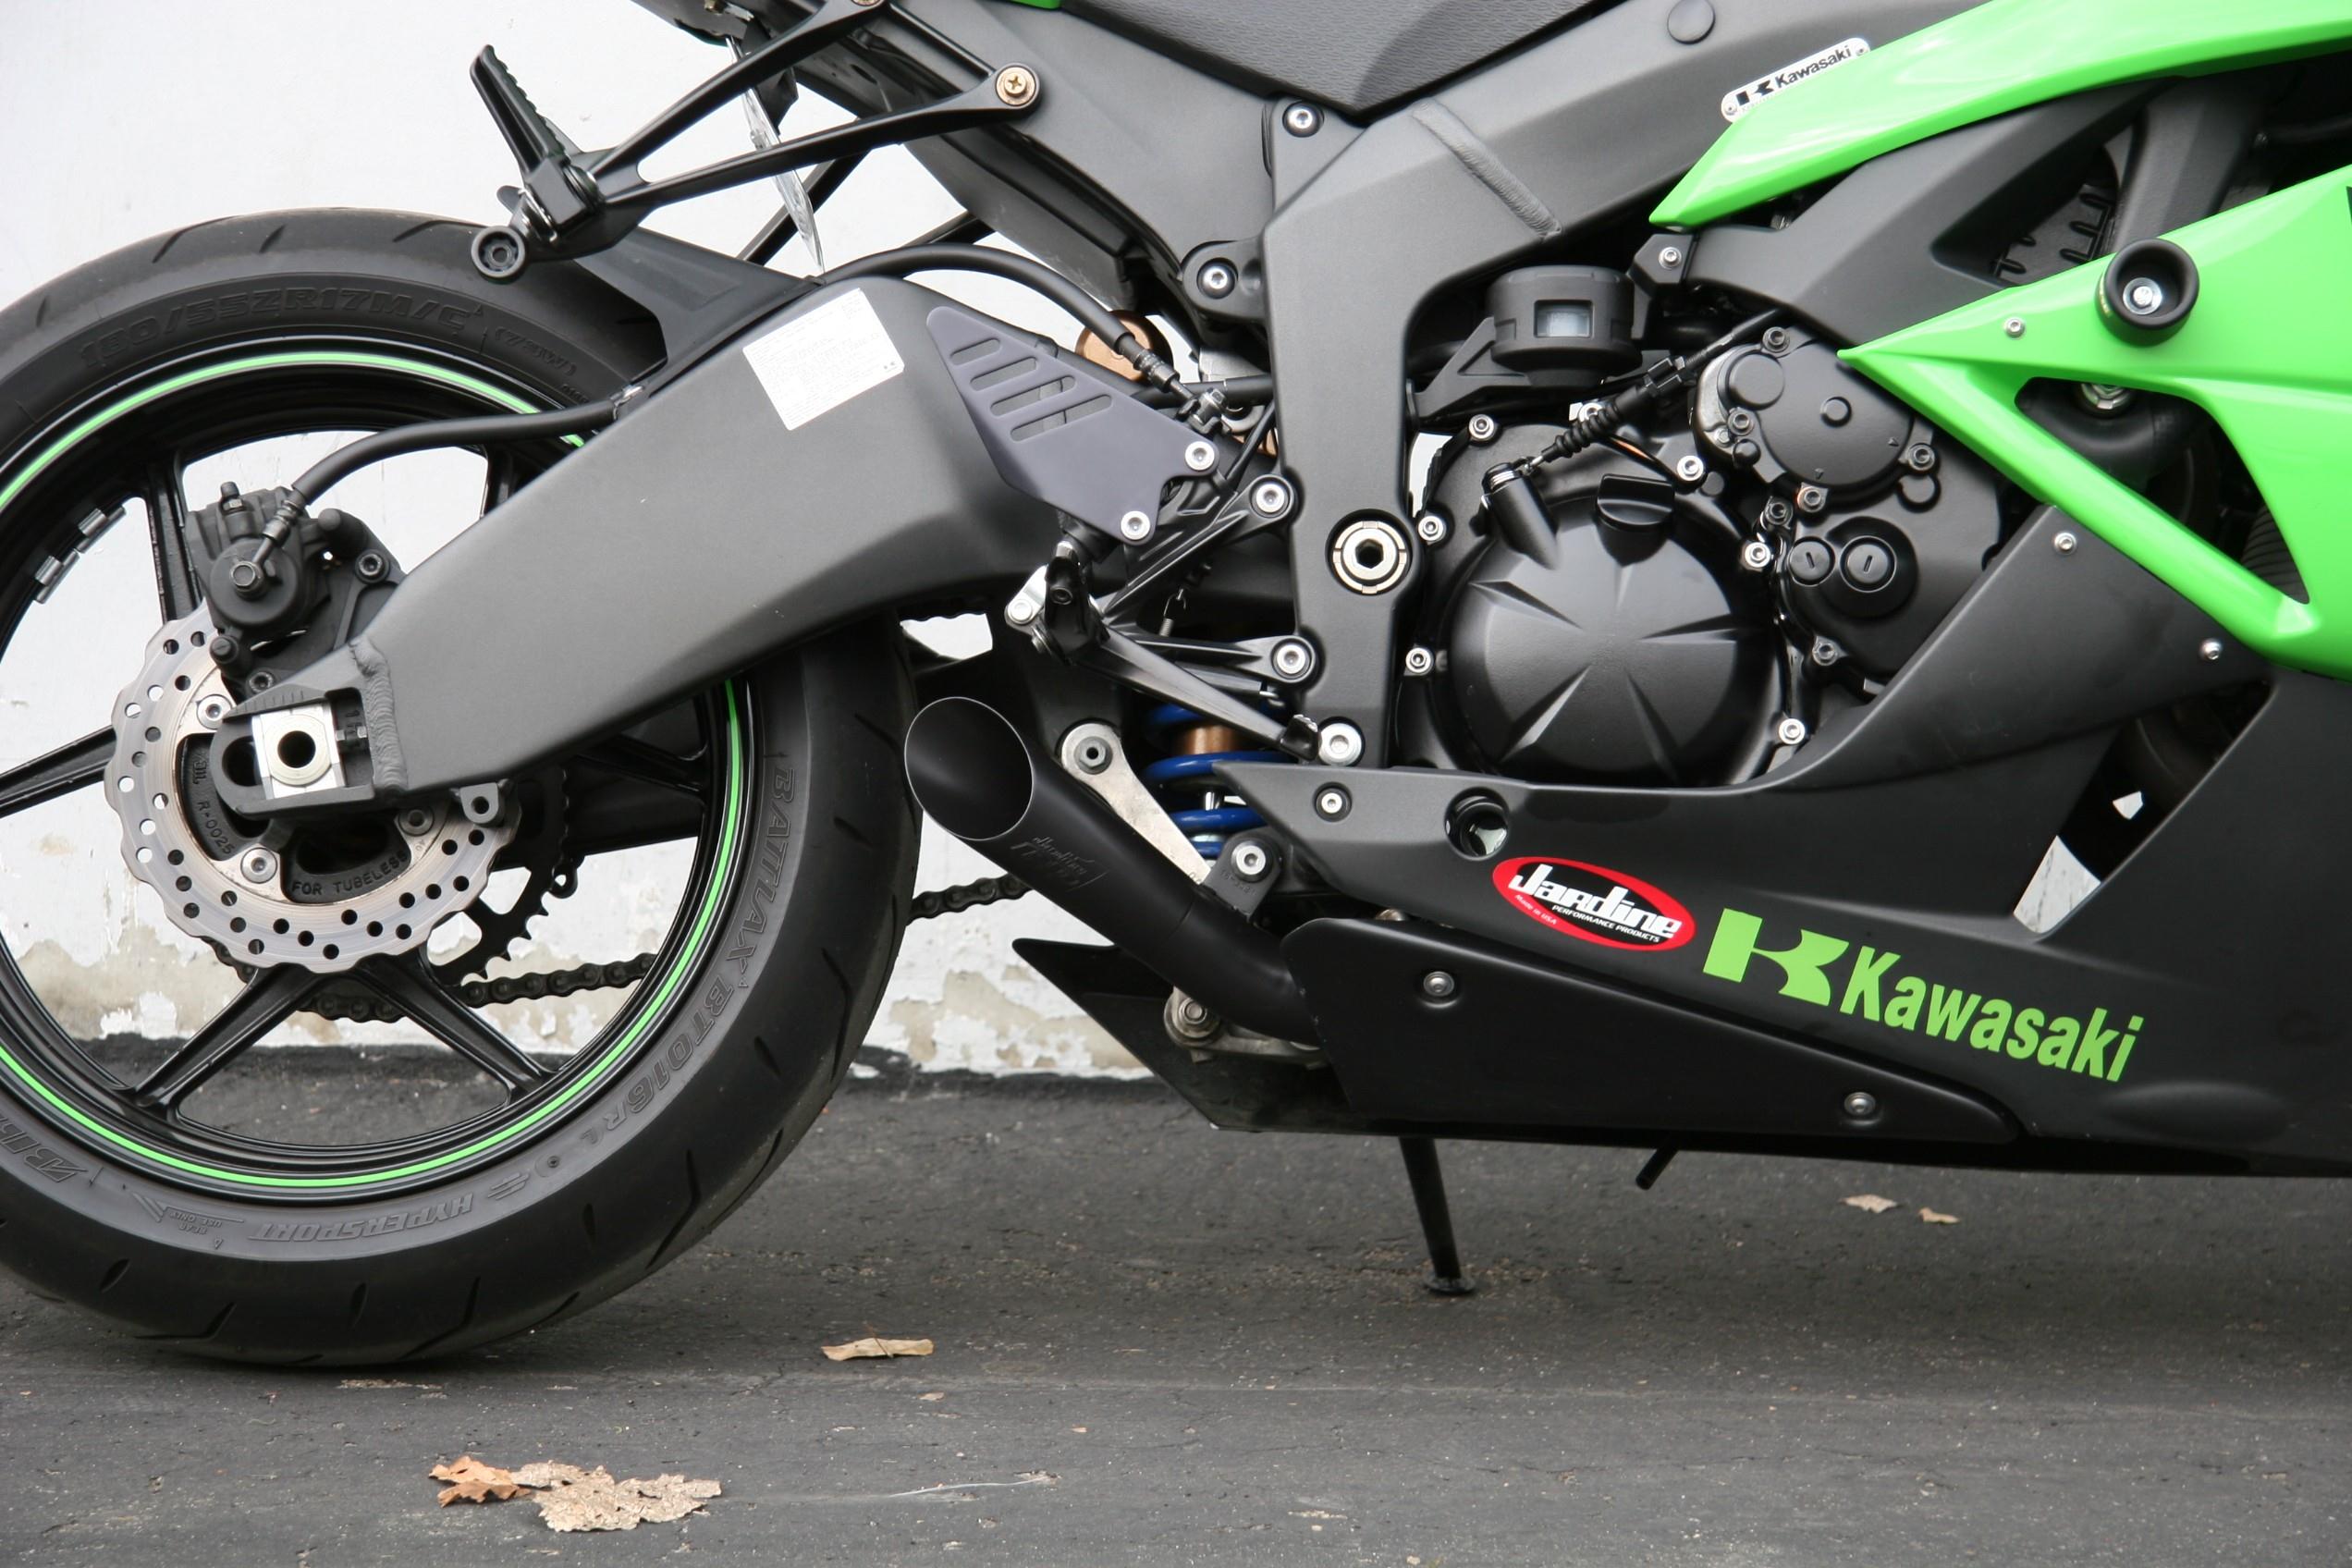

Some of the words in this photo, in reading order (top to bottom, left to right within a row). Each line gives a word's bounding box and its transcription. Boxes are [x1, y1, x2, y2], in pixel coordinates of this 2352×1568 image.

[1775, 46, 1851, 89] Kawasaki
[197, 801, 235, 854] R-0025
[291, 880, 323, 896] FOR
[333, 849, 408, 893] TUBELESS
[727, 768, 795, 975] BATTLAX
[1508, 864, 1683, 938] Jardine
[1513, 894, 1534, 912] Made
[1540, 912, 1558, 925] USA
[1551, 903, 1614, 929] PERFORMANCE
[1615, 924, 1660, 943] PRODUCTS
[1839, 945, 2145, 1084] Kawasaki
[246, 1193, 473, 1243] HYPERSPORT
